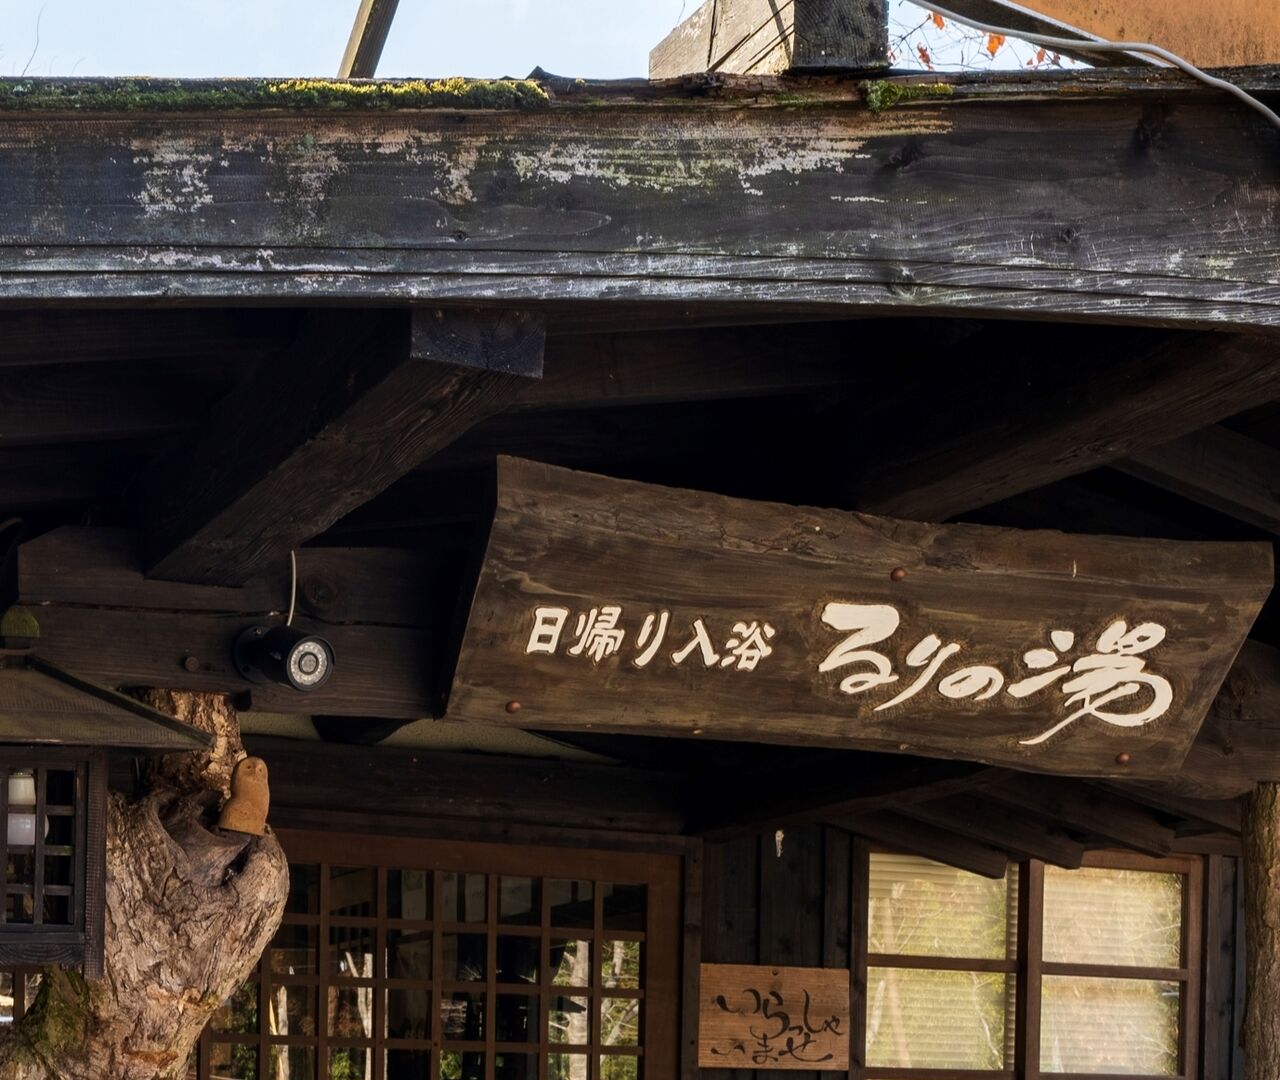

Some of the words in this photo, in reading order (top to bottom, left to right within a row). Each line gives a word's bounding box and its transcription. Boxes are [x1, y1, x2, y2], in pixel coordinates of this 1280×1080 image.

[526, 606, 776, 672] 日帰り入浴
[818, 602, 1173, 746] るりの湯
